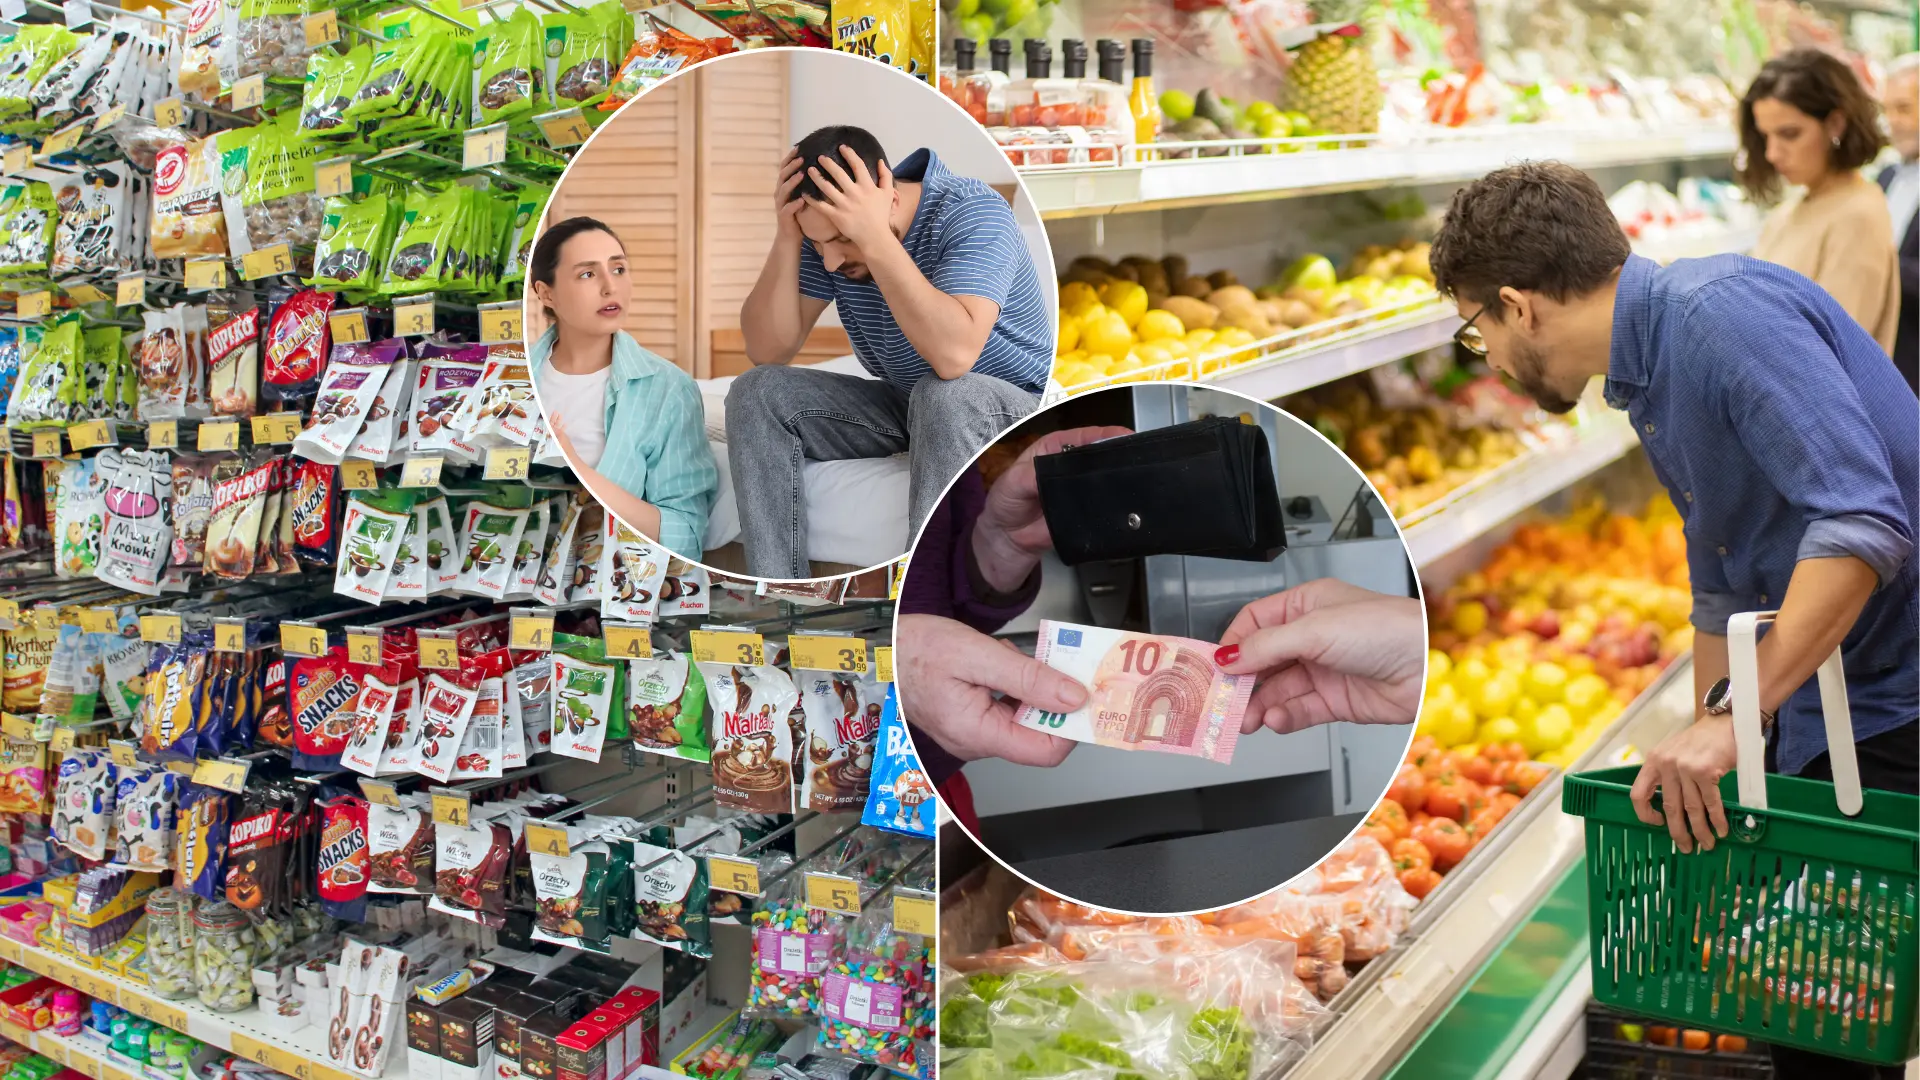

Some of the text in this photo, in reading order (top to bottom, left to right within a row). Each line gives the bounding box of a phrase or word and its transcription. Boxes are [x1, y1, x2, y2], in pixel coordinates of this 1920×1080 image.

[274, 254, 284, 271] 5
[412, 315, 424, 334] 3
[500, 320, 521, 341] 3 29
[286, 423, 297, 442] 5
[420, 466, 431, 485] 3
[504, 458, 519, 478] 3
[358, 470, 369, 488] 3
[110, 537, 156, 560] Krówki
[354, 583, 380, 597] Auchan
[396, 581, 423, 590] Auchan
[680, 600, 704, 609] Auchan
[227, 633, 236, 651] 4
[309, 636, 319, 655] 6
[530, 628, 543, 648] 4
[753, 642, 762, 650] PLN
[361, 645, 371, 664] 3
[627, 638, 641, 658] 4
[737, 643, 764, 666] 3 99
[855, 648, 865, 656] PLN
[1119, 638, 1161, 677] 10
[17, 651, 52, 668] Origin
[437, 649, 450, 668] 3
[838, 649, 867, 672] 3 99
[638, 679, 670, 694] Orzechy
[298, 673, 360, 734] SNACKS
[1037, 709, 1066, 729] 10
[1098, 711, 1127, 722] EURO
[835, 712, 880, 746] MaltBa
[572, 743, 597, 753] Auchan
[389, 757, 407, 765] Auch
[420, 759, 445, 775] Auchan
[222, 772, 235, 789] 4
[904, 793, 919, 804] m
[448, 807, 460, 826] 4
[229, 813, 273, 845] KOPIKO
[547, 838, 560, 856] 4
[539, 872, 571, 887] Orzechy
[643, 873, 676, 892] Orzechy
[733, 873, 748, 893] 5
[831, 889, 859, 912] 5 66
